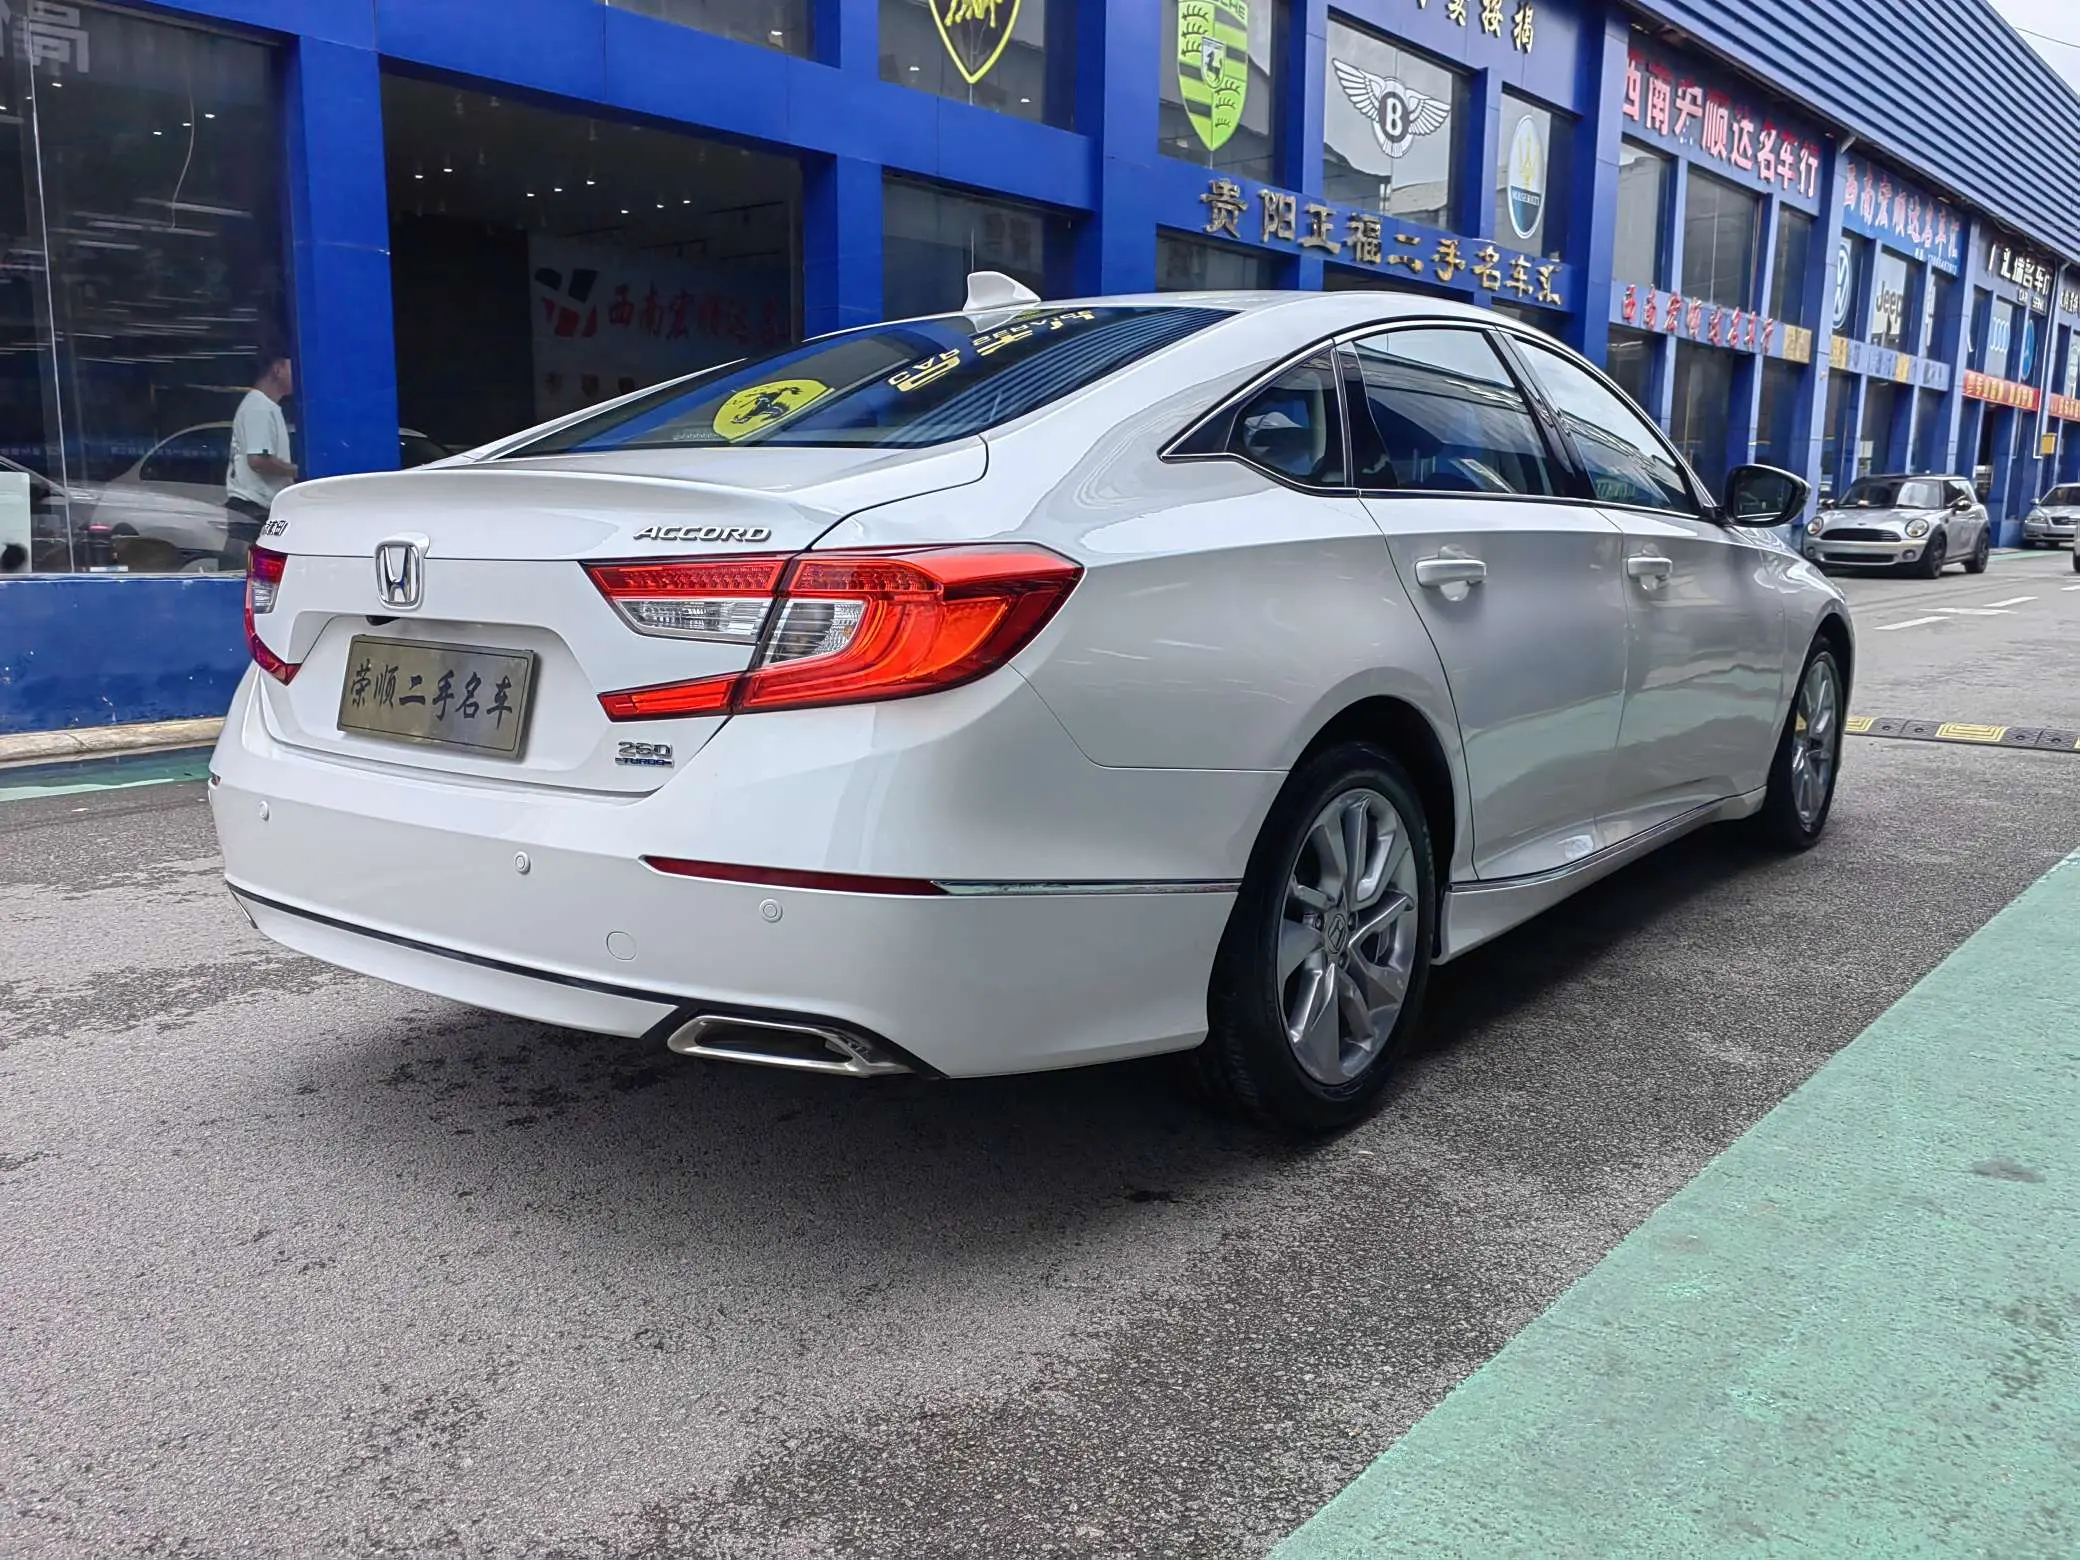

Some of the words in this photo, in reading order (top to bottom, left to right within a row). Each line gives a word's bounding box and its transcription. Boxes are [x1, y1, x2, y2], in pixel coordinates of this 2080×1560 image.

[633, 526, 772, 542] ACCORD
[351, 658, 513, 729] 荣顺二手名车
